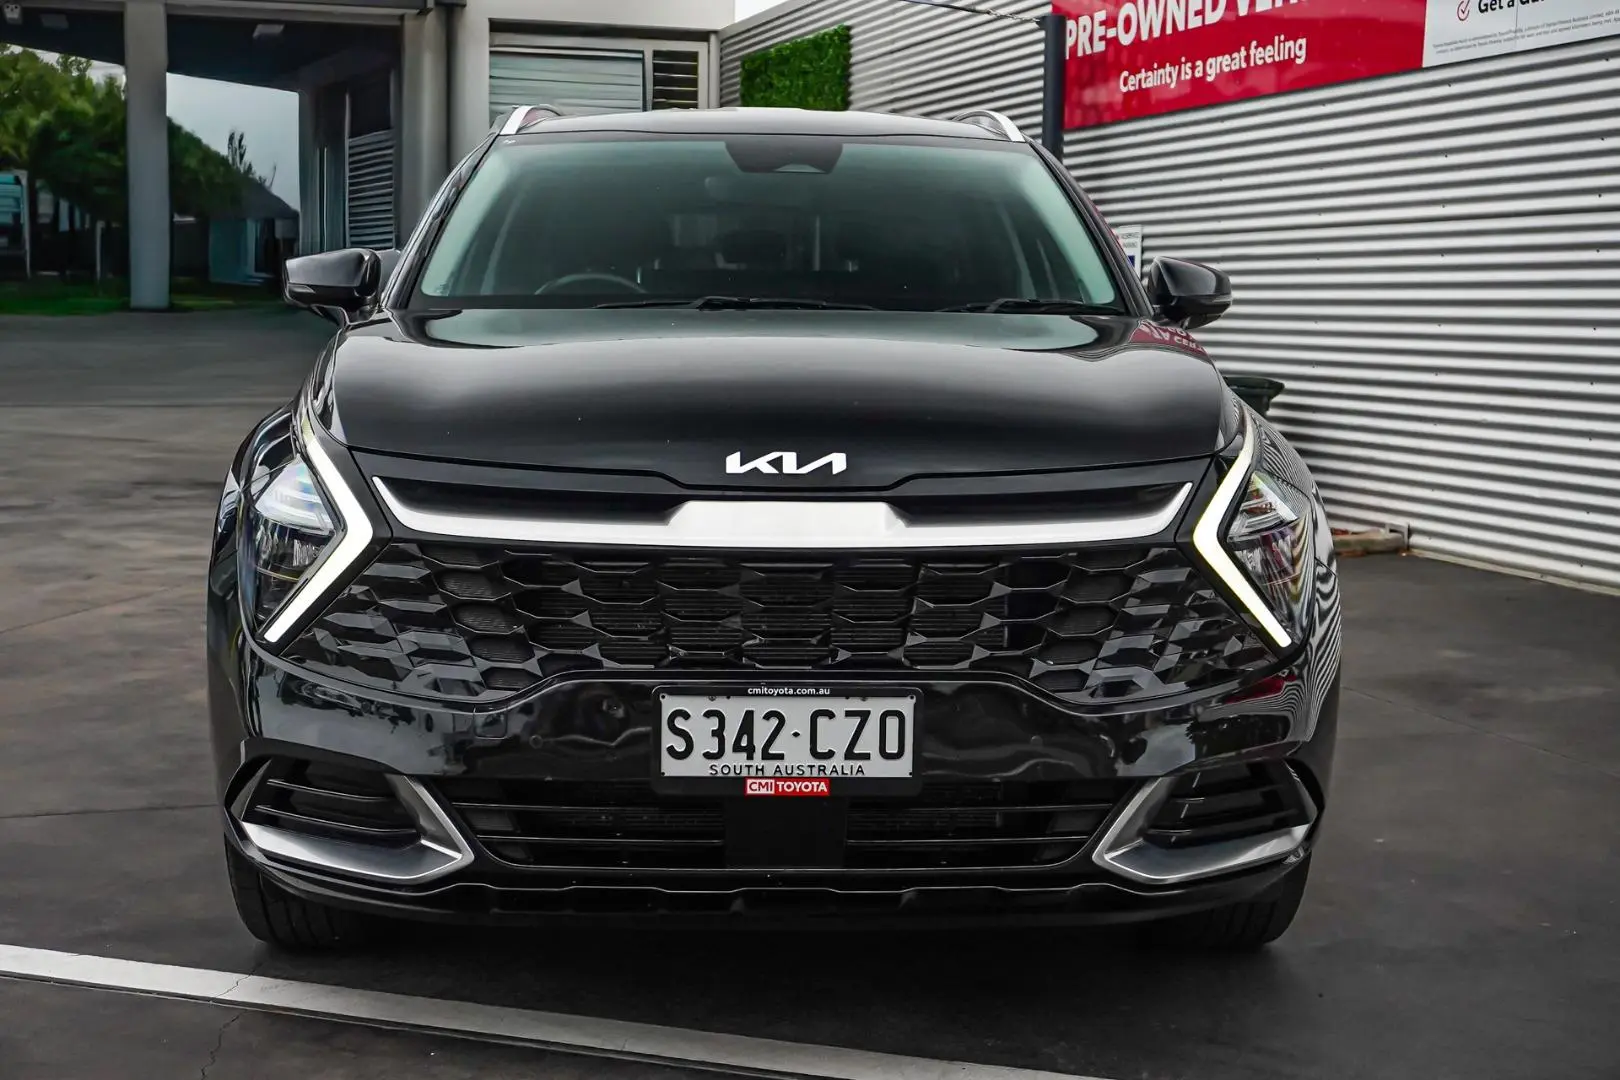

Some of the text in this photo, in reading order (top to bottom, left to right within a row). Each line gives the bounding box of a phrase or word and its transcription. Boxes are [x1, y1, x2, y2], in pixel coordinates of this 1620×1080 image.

[1478, 0, 1504, 14] Get
[1066, 0, 1225, 60] PRE-OWNED
[1119, 35, 1307, 93] Certainty is a great feeling
[747, 686, 830, 696] cmitoyota.com.au
[709, 764, 865, 776] SOUTH AUSTRALIA
[748, 780, 828, 793] CMI TOYOTA
